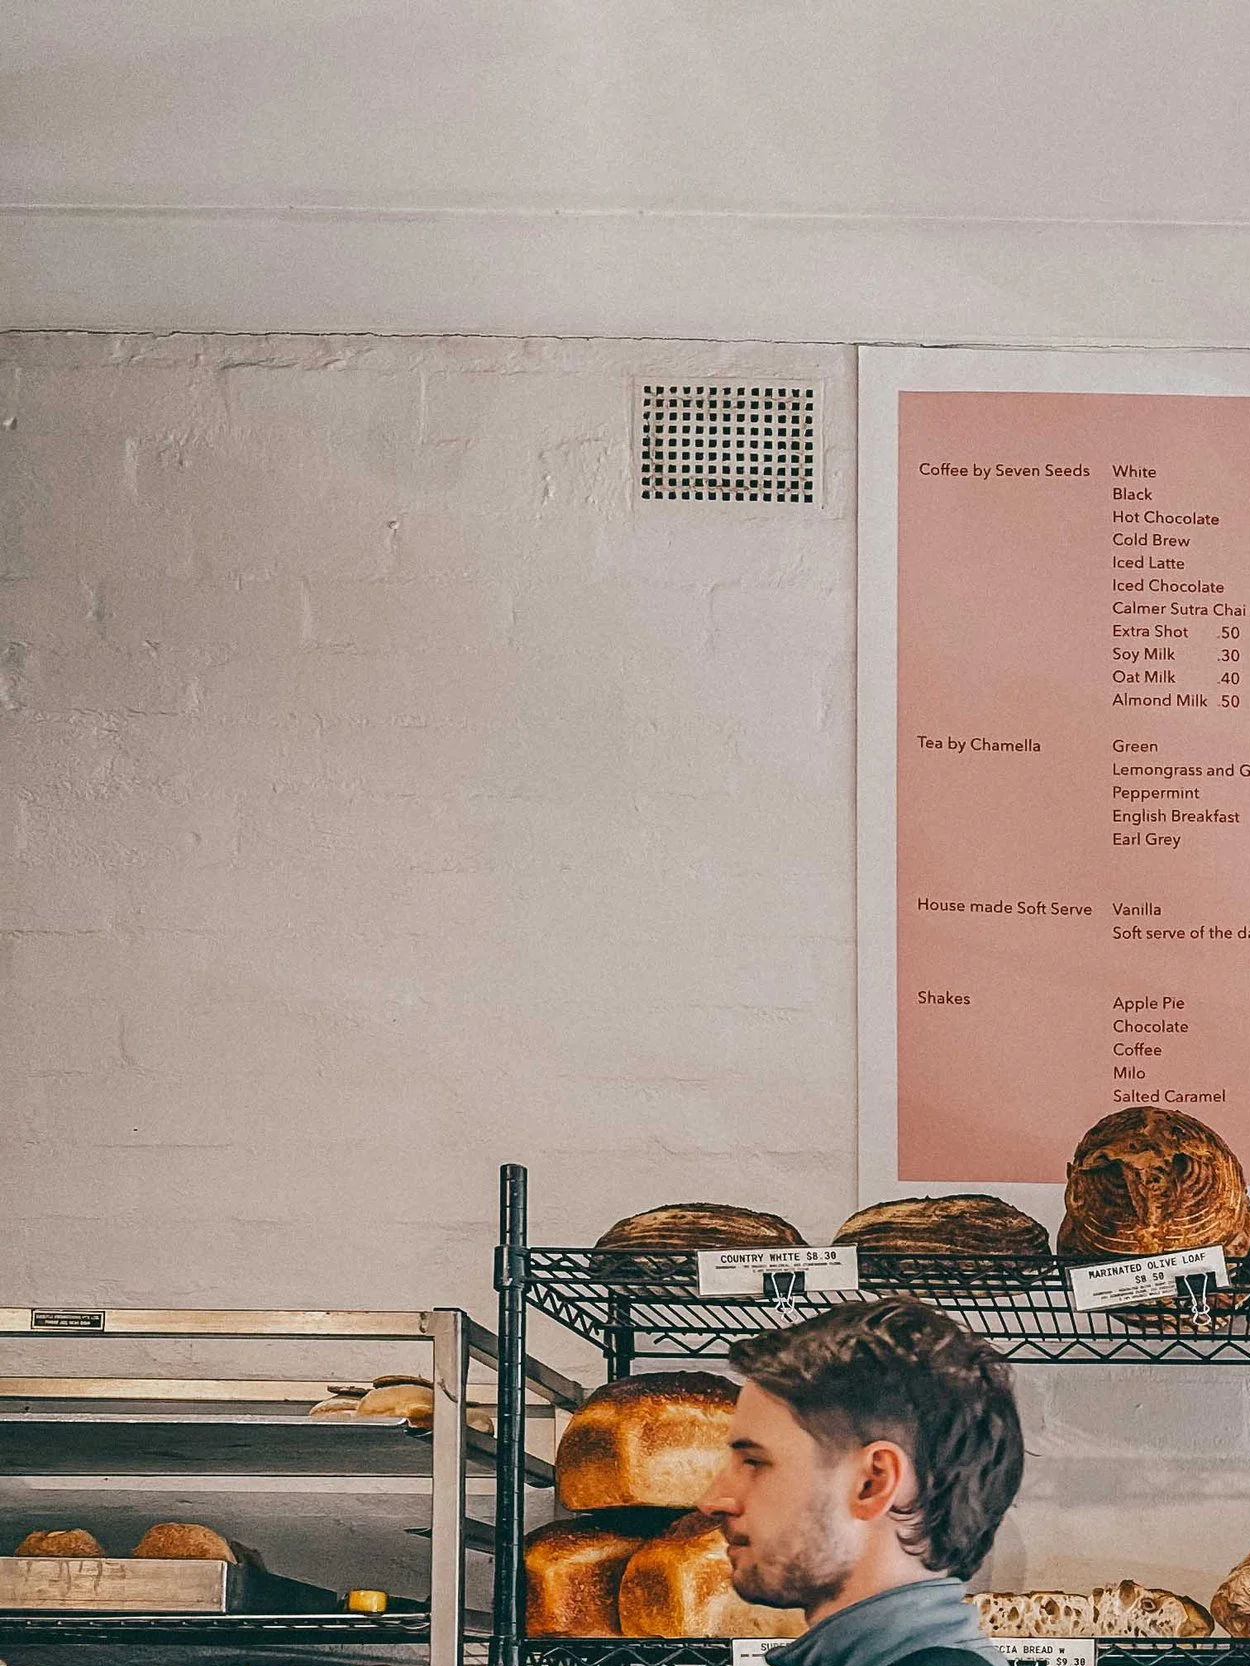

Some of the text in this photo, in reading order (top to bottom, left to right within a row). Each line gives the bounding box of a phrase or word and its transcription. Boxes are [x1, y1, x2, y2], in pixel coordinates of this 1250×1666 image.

[919, 462, 1091, 481] Coffee by Seven Seeds
[1112, 463, 1157, 479] White
[1112, 487, 1153, 501] Black
[1112, 510, 1140, 524] Hot
[1143, 510, 1220, 526] Chocolate
[1112, 532, 1148, 547] Cold
[1152, 533, 1191, 548] Brew
[1112, 555, 1144, 569] Iced
[1149, 555, 1185, 570] Latte
[1112, 578, 1144, 592] Iced
[1148, 578, 1225, 594] Chocolate
[1112, 600, 1167, 615] Calmer
[1170, 601, 1209, 616] Sutra
[1212, 602, 1246, 617] Chai
[1112, 624, 1240, 640] Extra Shot .50
[1112, 647, 1240, 664] Soy Milk .30
[1112, 669, 1240, 686] Oat Milk .40
[1112, 692, 1240, 709] Almond Milk .50
[916, 735, 1041, 755] Tea by Chamella
[1112, 739, 1158, 753] Green
[1112, 762, 1203, 780] Lemongrass
[1206, 763, 1235, 777] and
[1112, 785, 1200, 803] Peppermint
[1112, 807, 1167, 827] English
[1171, 808, 1241, 824] Breakfast
[1112, 831, 1141, 846] Earl
[1145, 832, 1182, 850] Grey
[917, 897, 1093, 916] House made Soft Serve
[1112, 901, 1162, 916] Vanilla
[1112, 925, 1143, 940] Soft
[1145, 929, 1186, 940] serve
[1189, 925, 1206, 940] of
[1208, 925, 1233, 940] the
[917, 989, 971, 1005] Shakes
[1112, 995, 1185, 1014] Apple Pie
[1112, 1019, 1189, 1034] Chocolate
[1113, 1041, 1163, 1057] Coffee
[1113, 1065, 1146, 1080] Milo
[1113, 1088, 1226, 1103] Salted Caramel
[720, 1251, 837, 1264] COUNTRY WHITE $8.30
[1088, 1252, 1207, 1280] MARINATED OLIVE LOAF
[1022, 1645, 1054, 1655] BREAD
